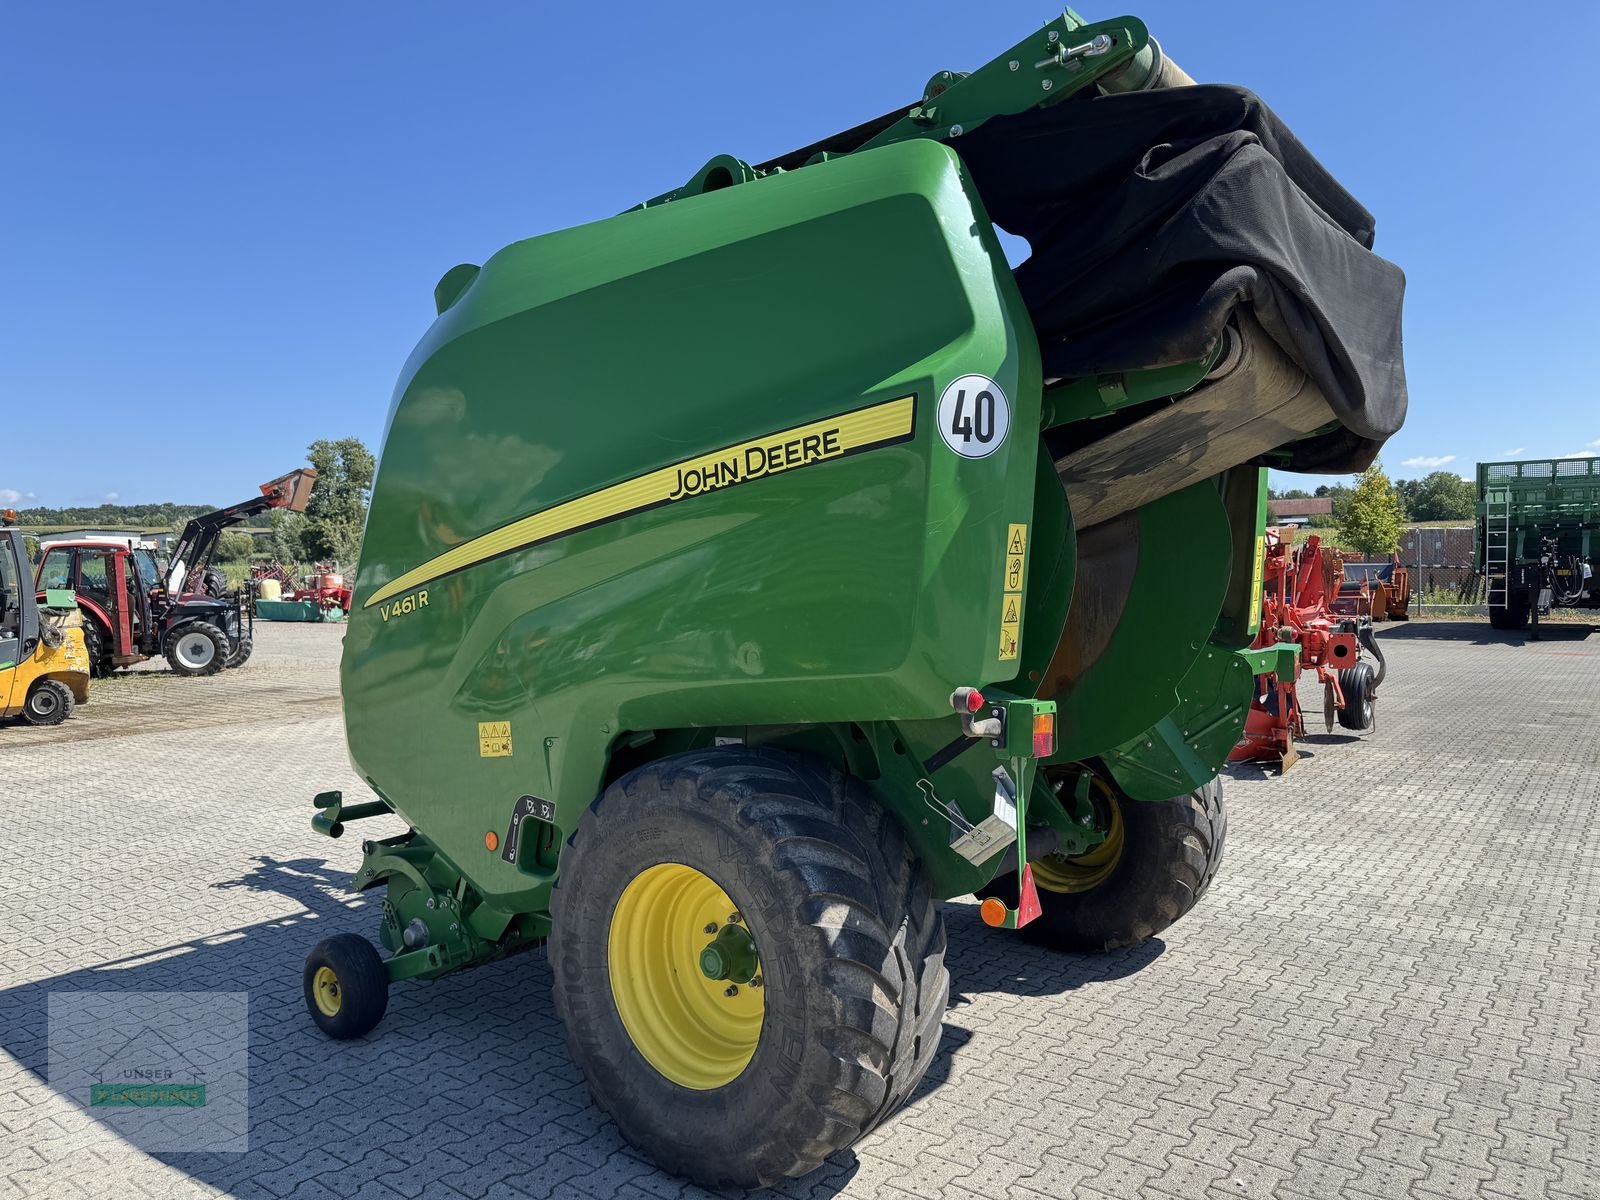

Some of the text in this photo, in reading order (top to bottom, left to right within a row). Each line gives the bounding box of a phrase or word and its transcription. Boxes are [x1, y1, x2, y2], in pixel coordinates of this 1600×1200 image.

[951, 390, 995, 443] 40
[669, 428, 841, 498] JOHN DEERE
[380, 590, 429, 622] V 461 R
[716, 827, 808, 1103] VREDESTEIN
